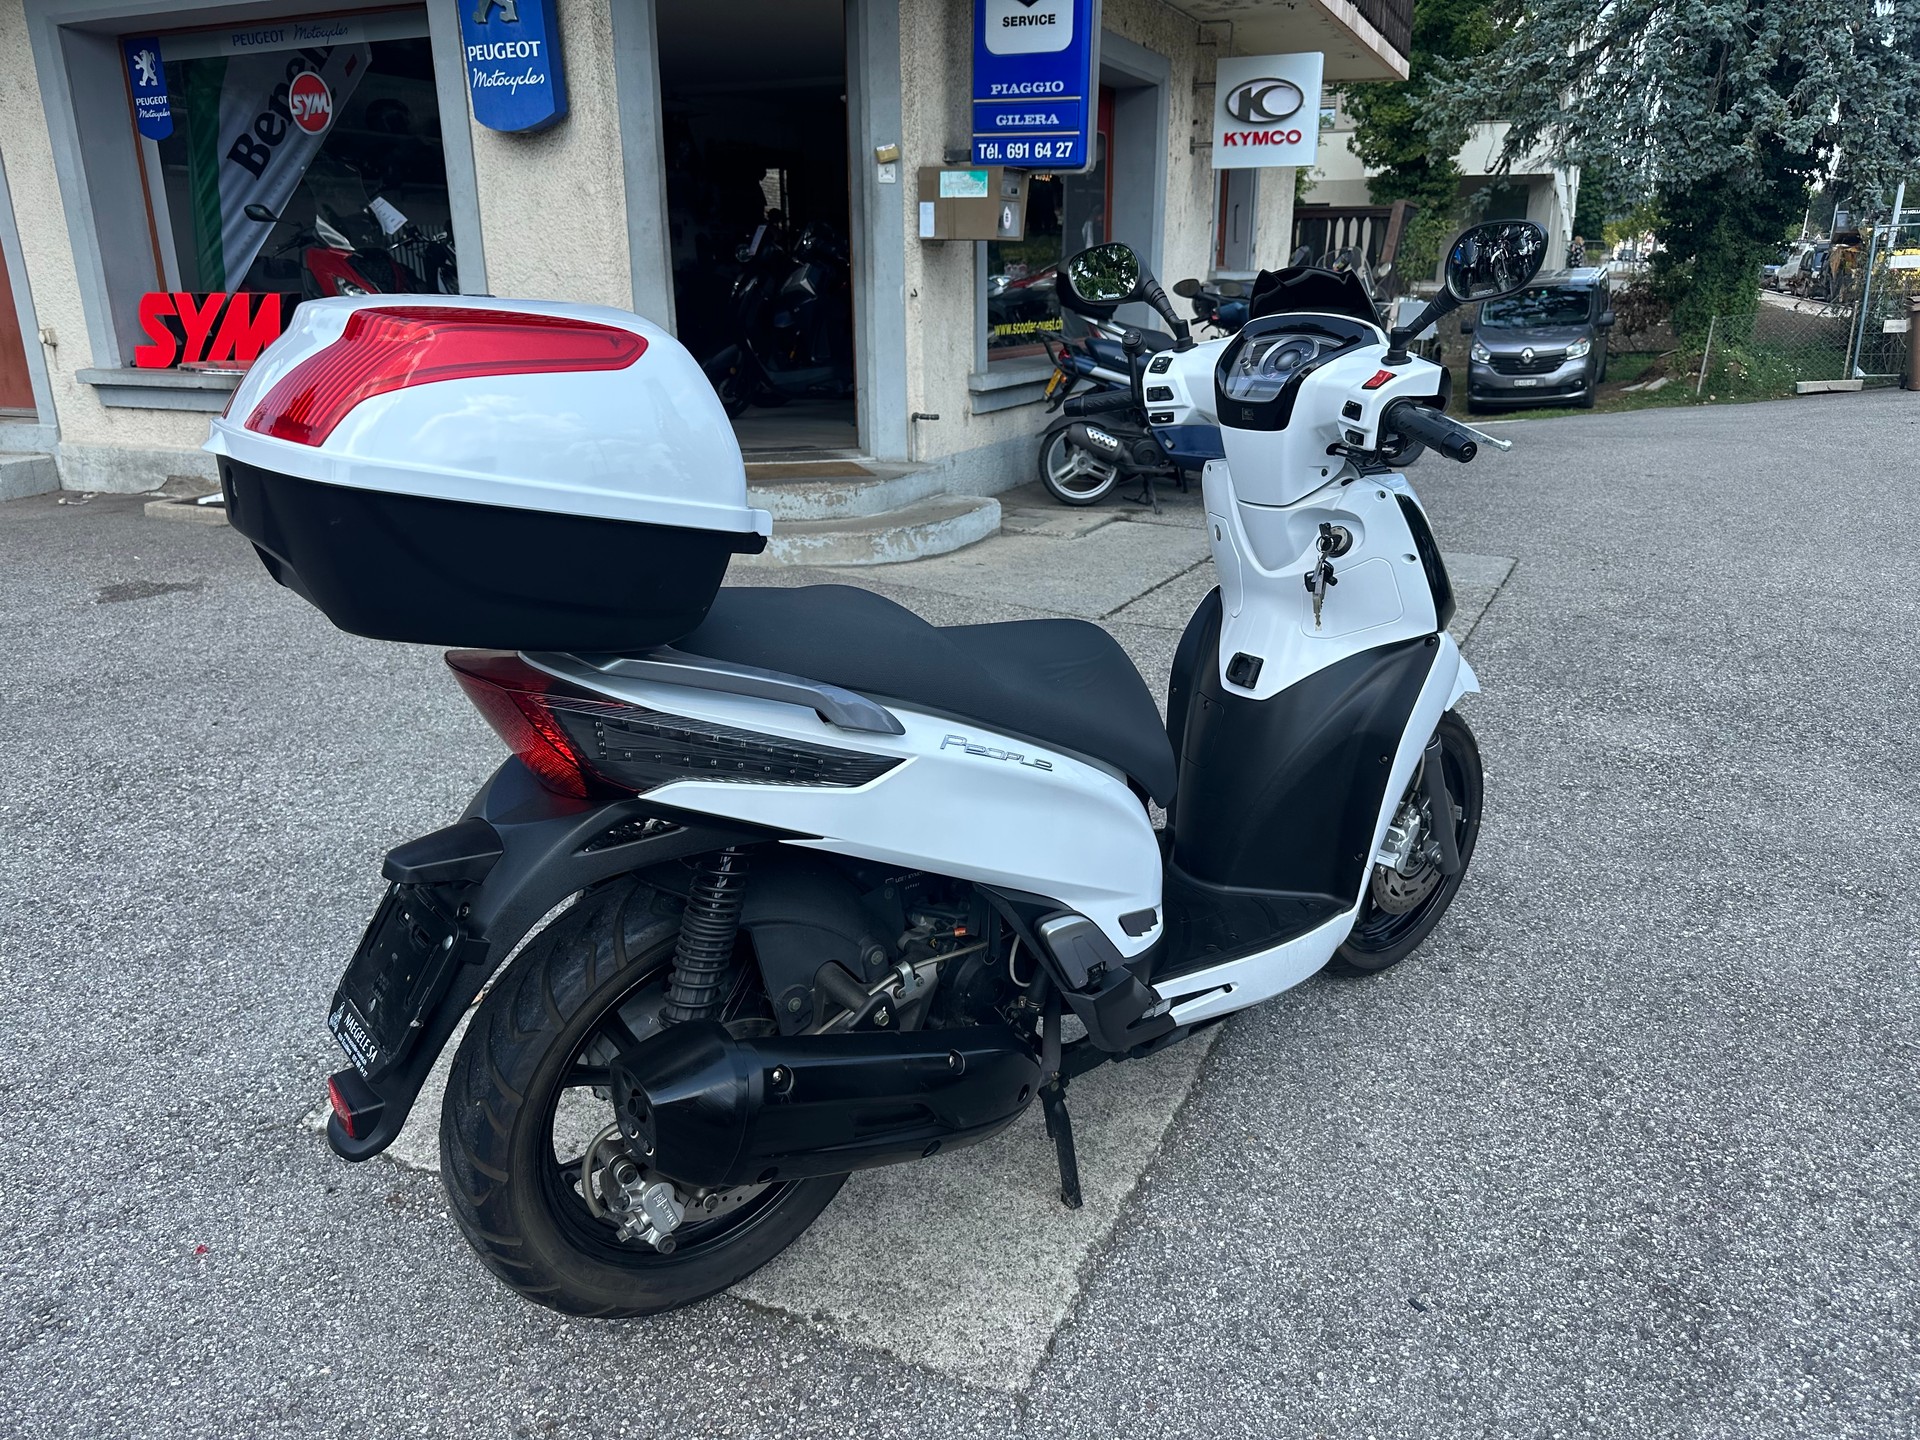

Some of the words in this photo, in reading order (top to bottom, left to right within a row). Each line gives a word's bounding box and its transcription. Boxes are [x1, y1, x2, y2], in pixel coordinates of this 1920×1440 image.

[1002, 14, 1056, 27] SERVICE
[232, 30, 285, 46] PEUGEOT
[293, 23, 348, 45] Motocycles
[468, 41, 540, 61] PEUGEOT
[473, 67, 545, 95] Motocycles
[991, 81, 1064, 95] PIAGGIO
[136, 95, 168, 106] PEUGEOT
[291, 92, 331, 120] SYM
[139, 108, 171, 121] Motocycles
[996, 114, 1059, 126] GILERA
[1224, 129, 1302, 147] KYMCO
[978, 143, 1002, 160] Tél.
[1006, 143, 1029, 158] 691
[1035, 142, 1051, 158] 64
[1056, 142, 1073, 158] 27
[135, 293, 281, 368] SYM
[343, 1012, 371, 1051] NAEGELE
[366, 1045, 378, 1063] SA
